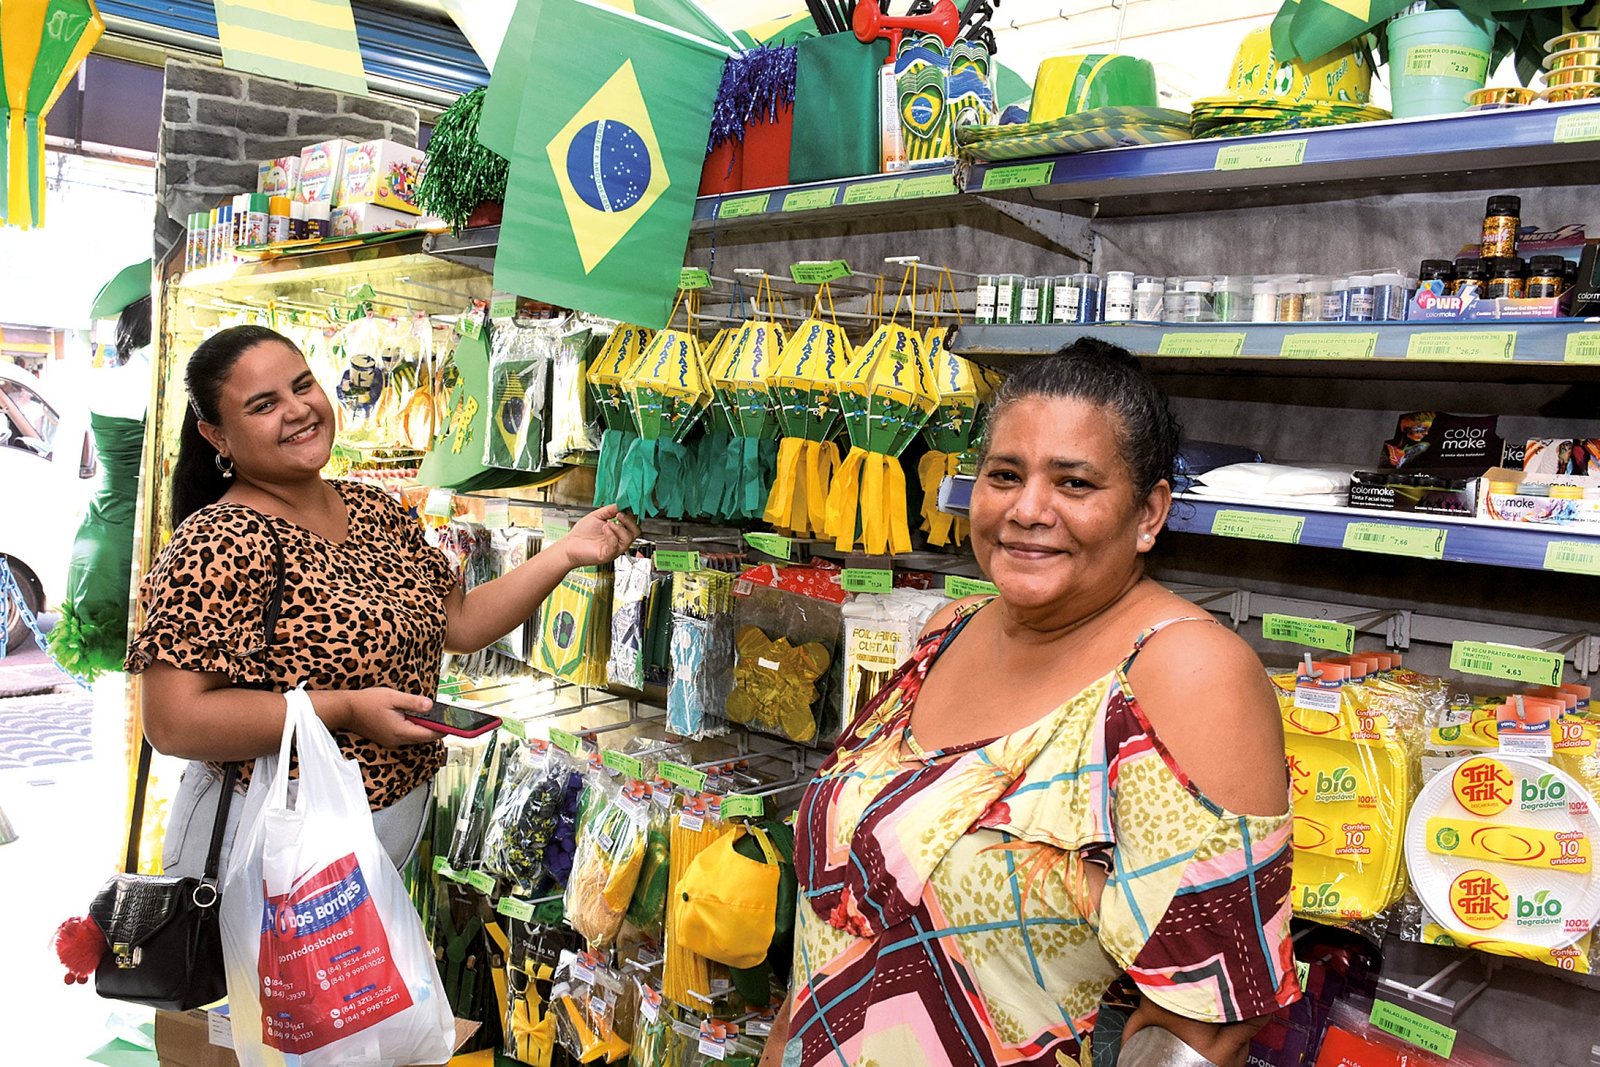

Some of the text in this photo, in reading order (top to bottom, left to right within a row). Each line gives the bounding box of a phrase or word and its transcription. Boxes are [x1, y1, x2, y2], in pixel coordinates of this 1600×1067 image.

[1455, 65, 1469, 73] 2,29
[1426, 297, 1460, 310] PWR
[613, 329, 633, 375] BRASIL
[653, 333, 676, 378] BRASIL
[752, 327, 766, 378] BRASIL
[795, 324, 821, 377] BRASIL
[825, 329, 836, 380] BRASIL
[854, 331, 887, 379] BRASIL
[678, 340, 688, 388] BRASIL
[910, 337, 929, 395] BRASIL
[1444, 426, 1488, 439] color
[1442, 438, 1484, 449] make
[1351, 486, 1395, 496] colormake
[853, 628, 872, 640] FOIL
[1309, 636, 1325, 644] 10,11
[1506, 668, 1522, 676] 4,63
[1360, 718, 1374, 731] 10
[1562, 724, 1583, 739] 10
[1554, 739, 1590, 749] unidades
[1316, 767, 1357, 794] bio
[1461, 763, 1513, 786] Trik
[1461, 782, 1513, 805] Trik
[1521, 773, 1566, 802] bio
[1315, 791, 1355, 801] Degradável
[1521, 800, 1565, 811] Degradável
[1568, 801, 1588, 810] 100%
[1342, 822, 1370, 831] Contém
[1345, 832, 1364, 846] 10
[1555, 830, 1584, 840] Contém
[1335, 847, 1370, 855] unidades
[1560, 841, 1579, 856] 10
[1550, 856, 1585, 865] unidades
[1302, 883, 1340, 908] bio
[1458, 876, 1509, 901] Trik
[288, 911, 314, 929] DOS
[315, 880, 361, 920] BOTÕES
[1457, 896, 1508, 920] Trik
[1517, 889, 1562, 918] bio
[1517, 918, 1561, 927] Degradável
[1564, 919, 1589, 928] 100%
[547, 948, 556, 957] Kit
[1551, 947, 1581, 956] Contém
[327, 946, 380, 975] (84) 3234-4849
[1556, 957, 1574, 971] 10
[330, 974, 345, 986] (84)
[352, 956, 386, 976] 9991-1022
[341, 985, 393, 1014] (84) 3213-5252
[345, 1013, 360, 1024] (84)
[366, 993, 400, 1013] 9987-2211
[1420, 1038, 1439, 1051] 11,69
